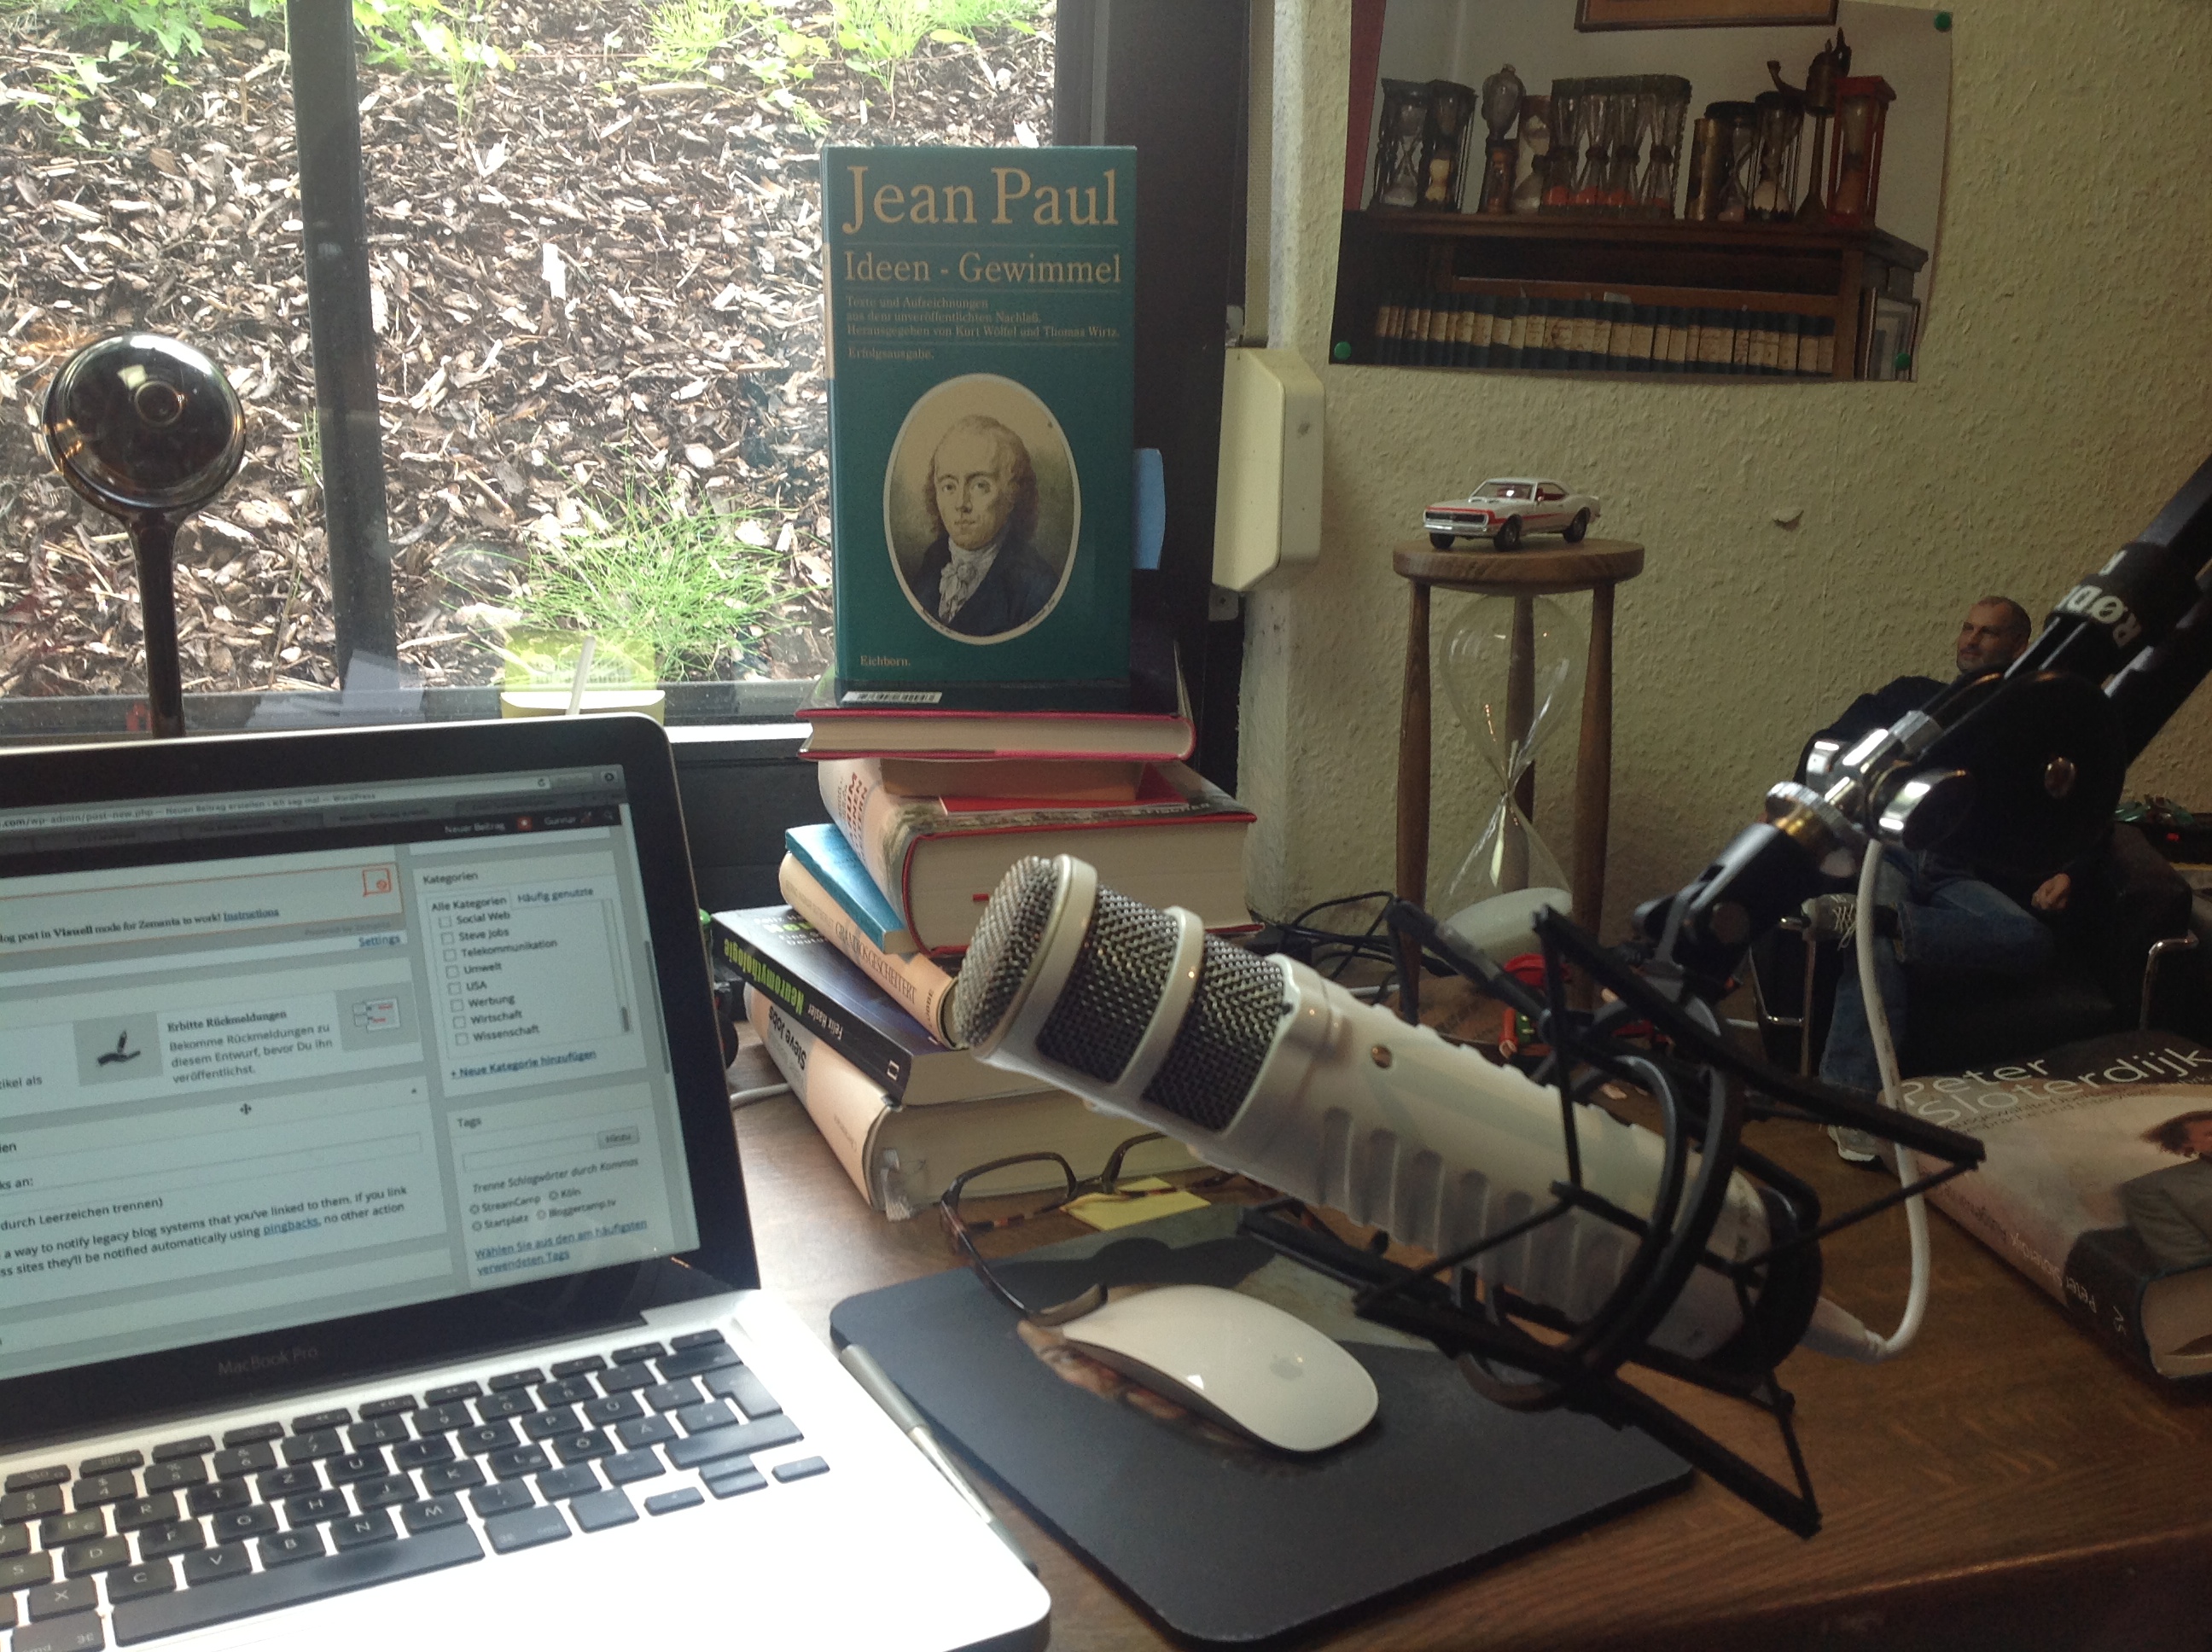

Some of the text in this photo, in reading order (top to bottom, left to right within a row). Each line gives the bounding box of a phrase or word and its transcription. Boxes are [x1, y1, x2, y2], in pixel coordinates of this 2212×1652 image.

[842, 166, 1119, 235] Jean Paul
[844, 251, 930, 282] Ideen
[959, 251, 1121, 284] Gewimmel
[880, 297, 899, 308] und
[423, 871, 479, 885] Kategorien
[432, 887, 593, 911] Alle Kategorien Häufig genutzte
[18, 931, 39, 944] post
[41, 929, 51, 939] in
[53, 924, 93, 938] Visuell
[95, 922, 121, 934] mode
[123, 921, 137, 931] for
[183, 916, 192, 925] to
[224, 908, 280, 922] Instructions
[457, 910, 510, 925] Social Web
[358, 934, 400, 948] Settings
[459, 928, 509, 942] Steve Jobs
[461, 939, 558, 957] Telekommunikation
[463, 961, 502, 975] Umwelt
[724, 937, 806, 1016] Neuromythologie
[466, 980, 487, 992] USA
[468, 995, 515, 1009] Werbung
[167, 1010, 288, 1032] Erbitte Rückmeldungen
[470, 1009, 522, 1025] Wirtschaft
[170, 1024, 330, 1052] Bekomme Rückmeldungen zu
[473, 1024, 540, 1042] Wissenschaft
[172, 1038, 333, 1068] diesem Entwurf, bevor Du ihn
[784, 1031, 807, 1071] Steve
[459, 1050, 597, 1079] Neue Kategorie hinzufügen
[26, 1074, 43, 1087] als
[1917, 1047, 2212, 1126] Sloterdijk
[457, 1116, 482, 1131] Tags
[473, 1180, 505, 1193] Trenne
[571, 1163, 597, 1178] durch
[1, 1196, 164, 1231] durch Leerzeichen trennen)
[481, 1195, 541, 1213] StreamCamp
[14, 1245, 38, 1257] way
[42, 1243, 54, 1254] to
[56, 1237, 90, 1253] notify
[92, 1232, 129, 1247] legacy
[132, 1224, 158, 1238] blog
[160, 1219, 206, 1236] systems
[208, 1214, 231, 1228] that
[271, 1201, 305, 1217] linked
[307, 1201, 319, 1211] to
[364, 1191, 385, 1204] you
[387, 1185, 407, 1198] link
[16, 1261, 44, 1276] sites
[48, 1254, 82, 1271] they'll
[85, 1253, 101, 1264] be
[103, 1243, 148, 1261] notified
[151, 1230, 227, 1254] automatically
[230, 1224, 260, 1240] using
[324, 1213, 339, 1225] no
[341, 1207, 369, 1222] other
[372, 1201, 405, 1216] action
